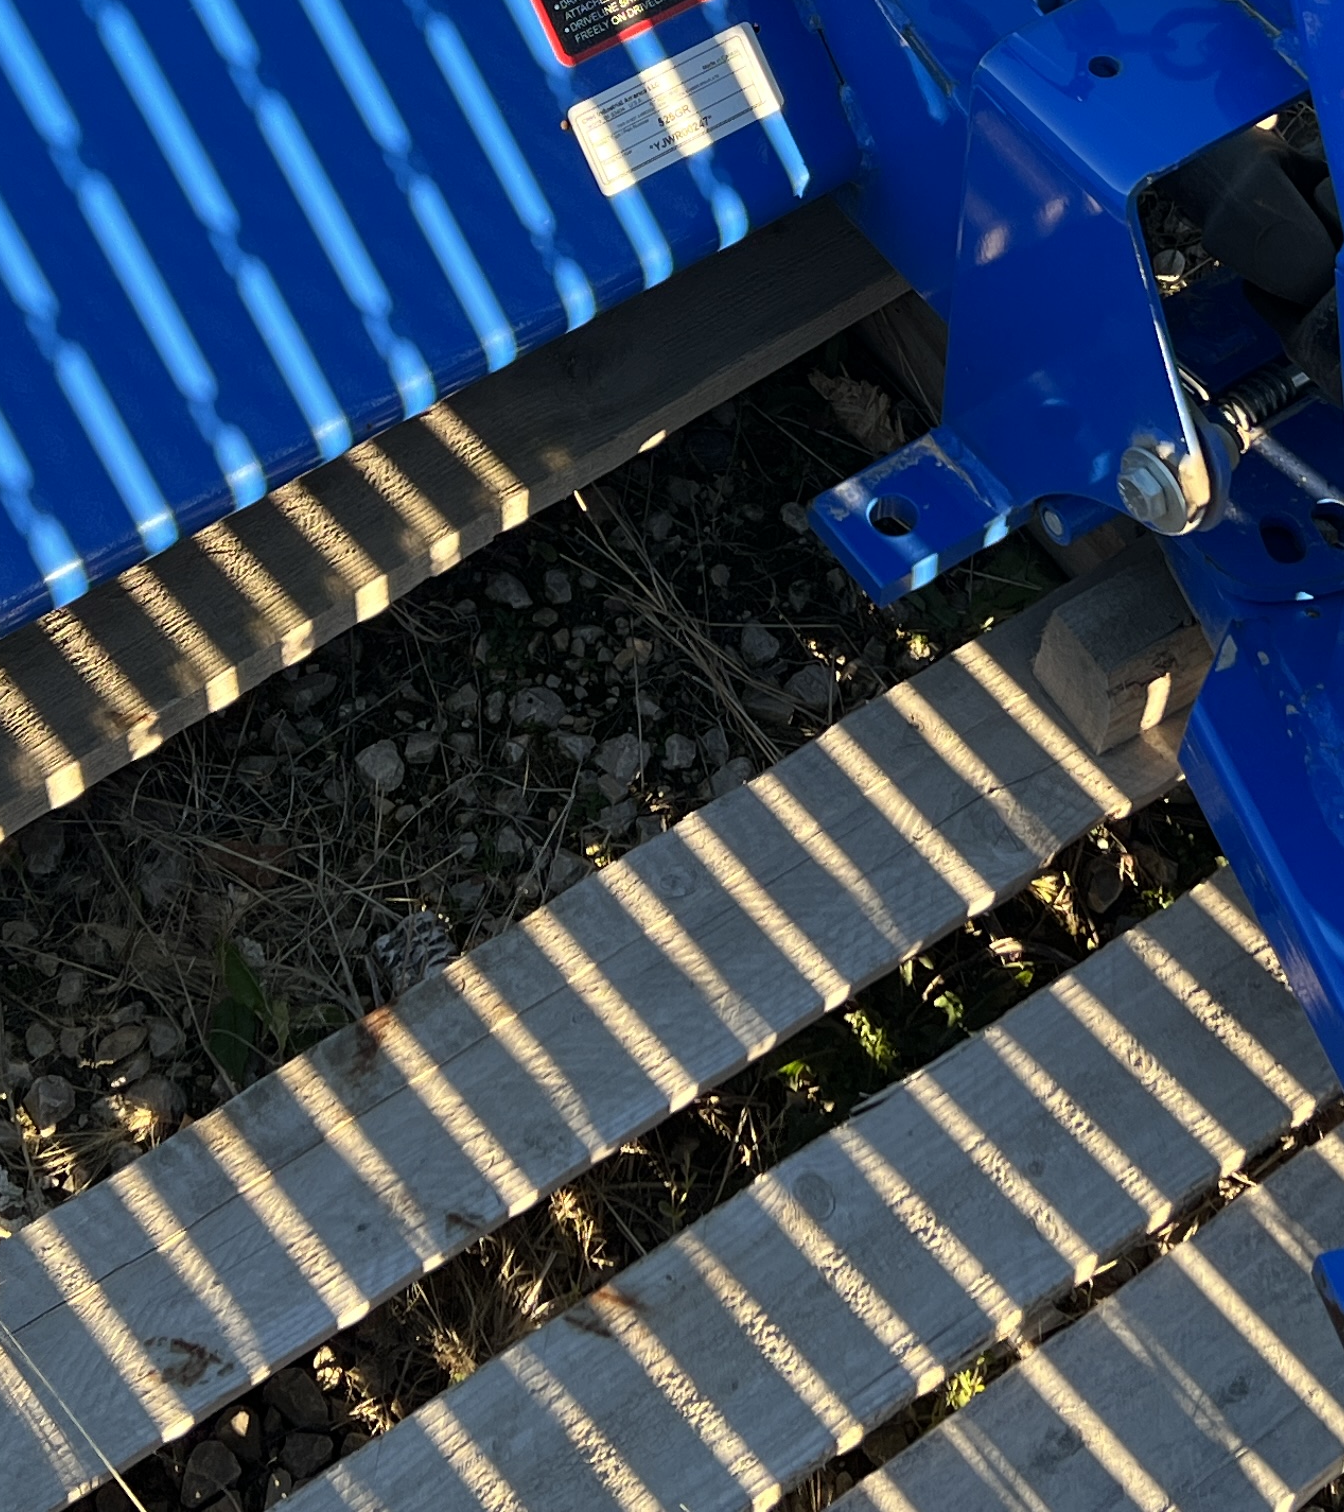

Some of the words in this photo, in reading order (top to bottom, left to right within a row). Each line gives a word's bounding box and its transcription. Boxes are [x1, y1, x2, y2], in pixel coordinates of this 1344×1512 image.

[569, 0, 619, 34] DRIVELINE
[574, 18, 610, 45] FREELY
[610, 11, 627, 26] ON
